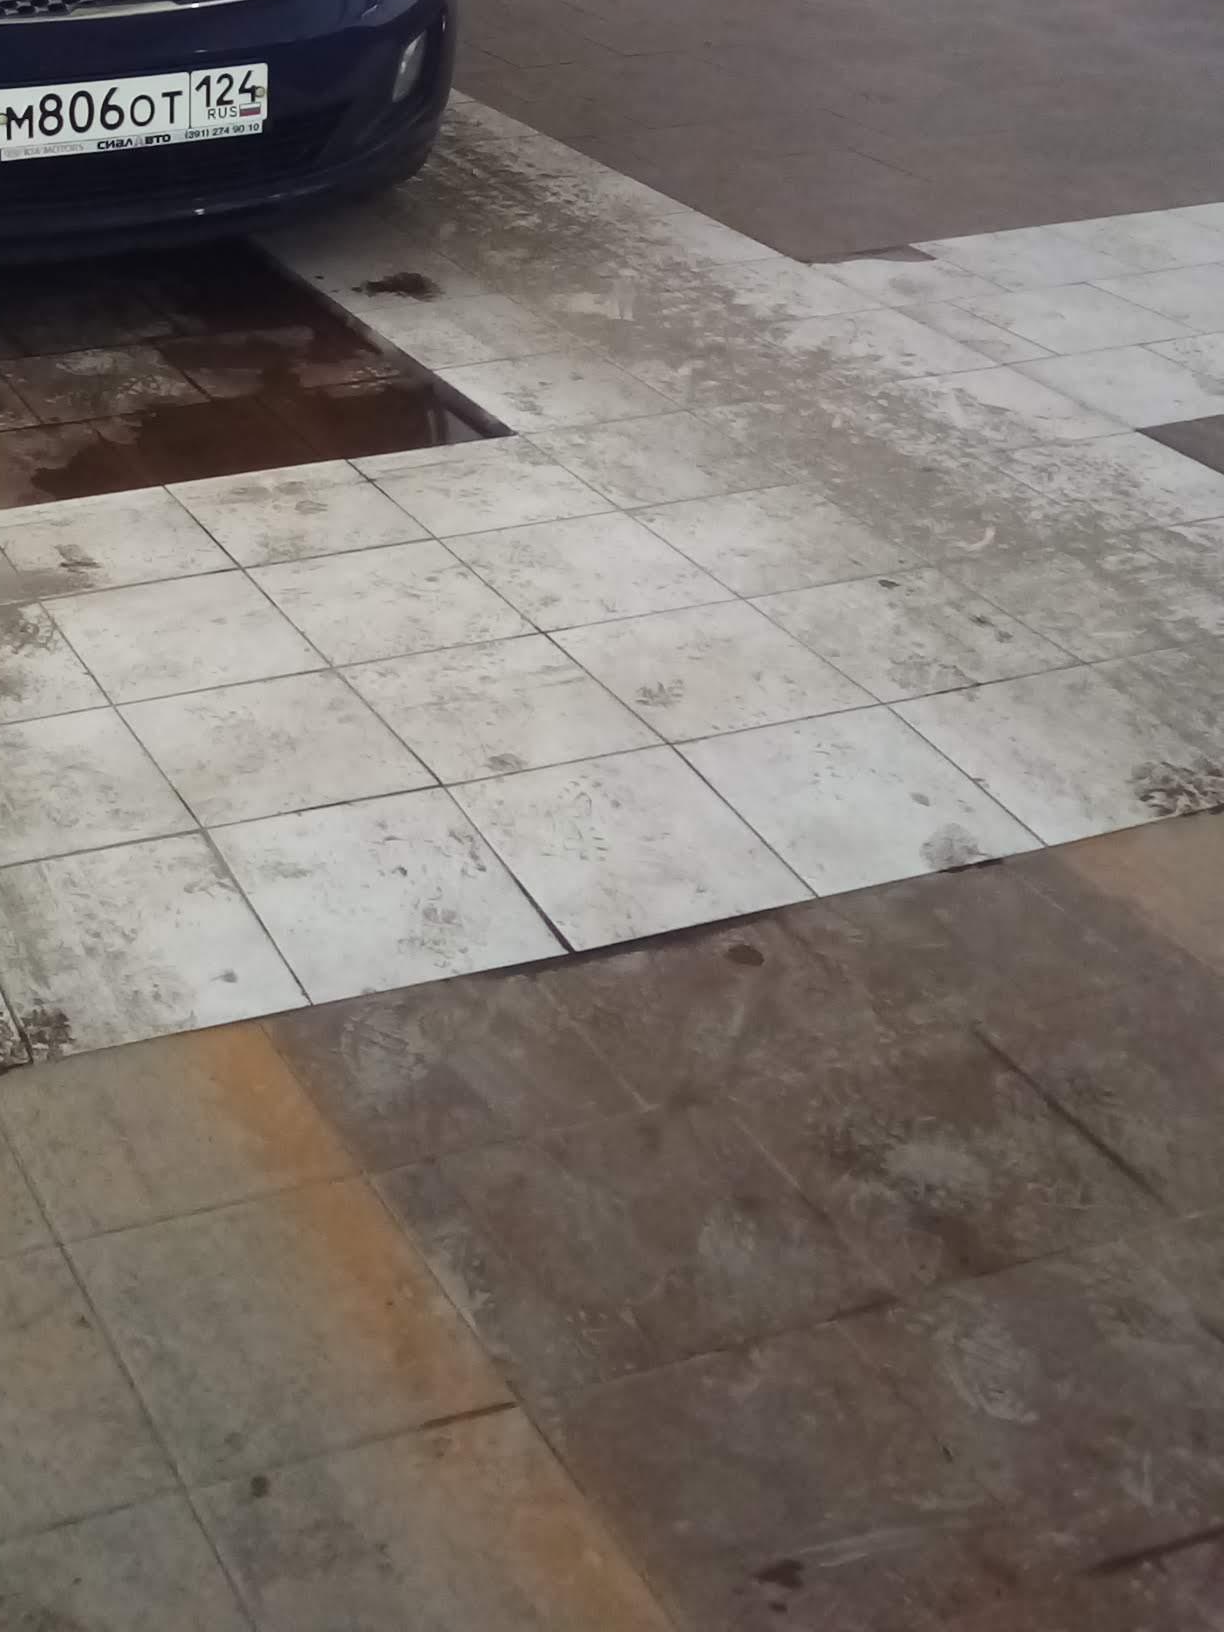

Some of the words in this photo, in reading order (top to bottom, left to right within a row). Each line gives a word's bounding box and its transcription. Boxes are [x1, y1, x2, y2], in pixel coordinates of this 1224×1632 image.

[5, 87, 184, 141] М806ОТ
[195, 70, 257, 108] 124
[207, 106, 237, 120] RUS
